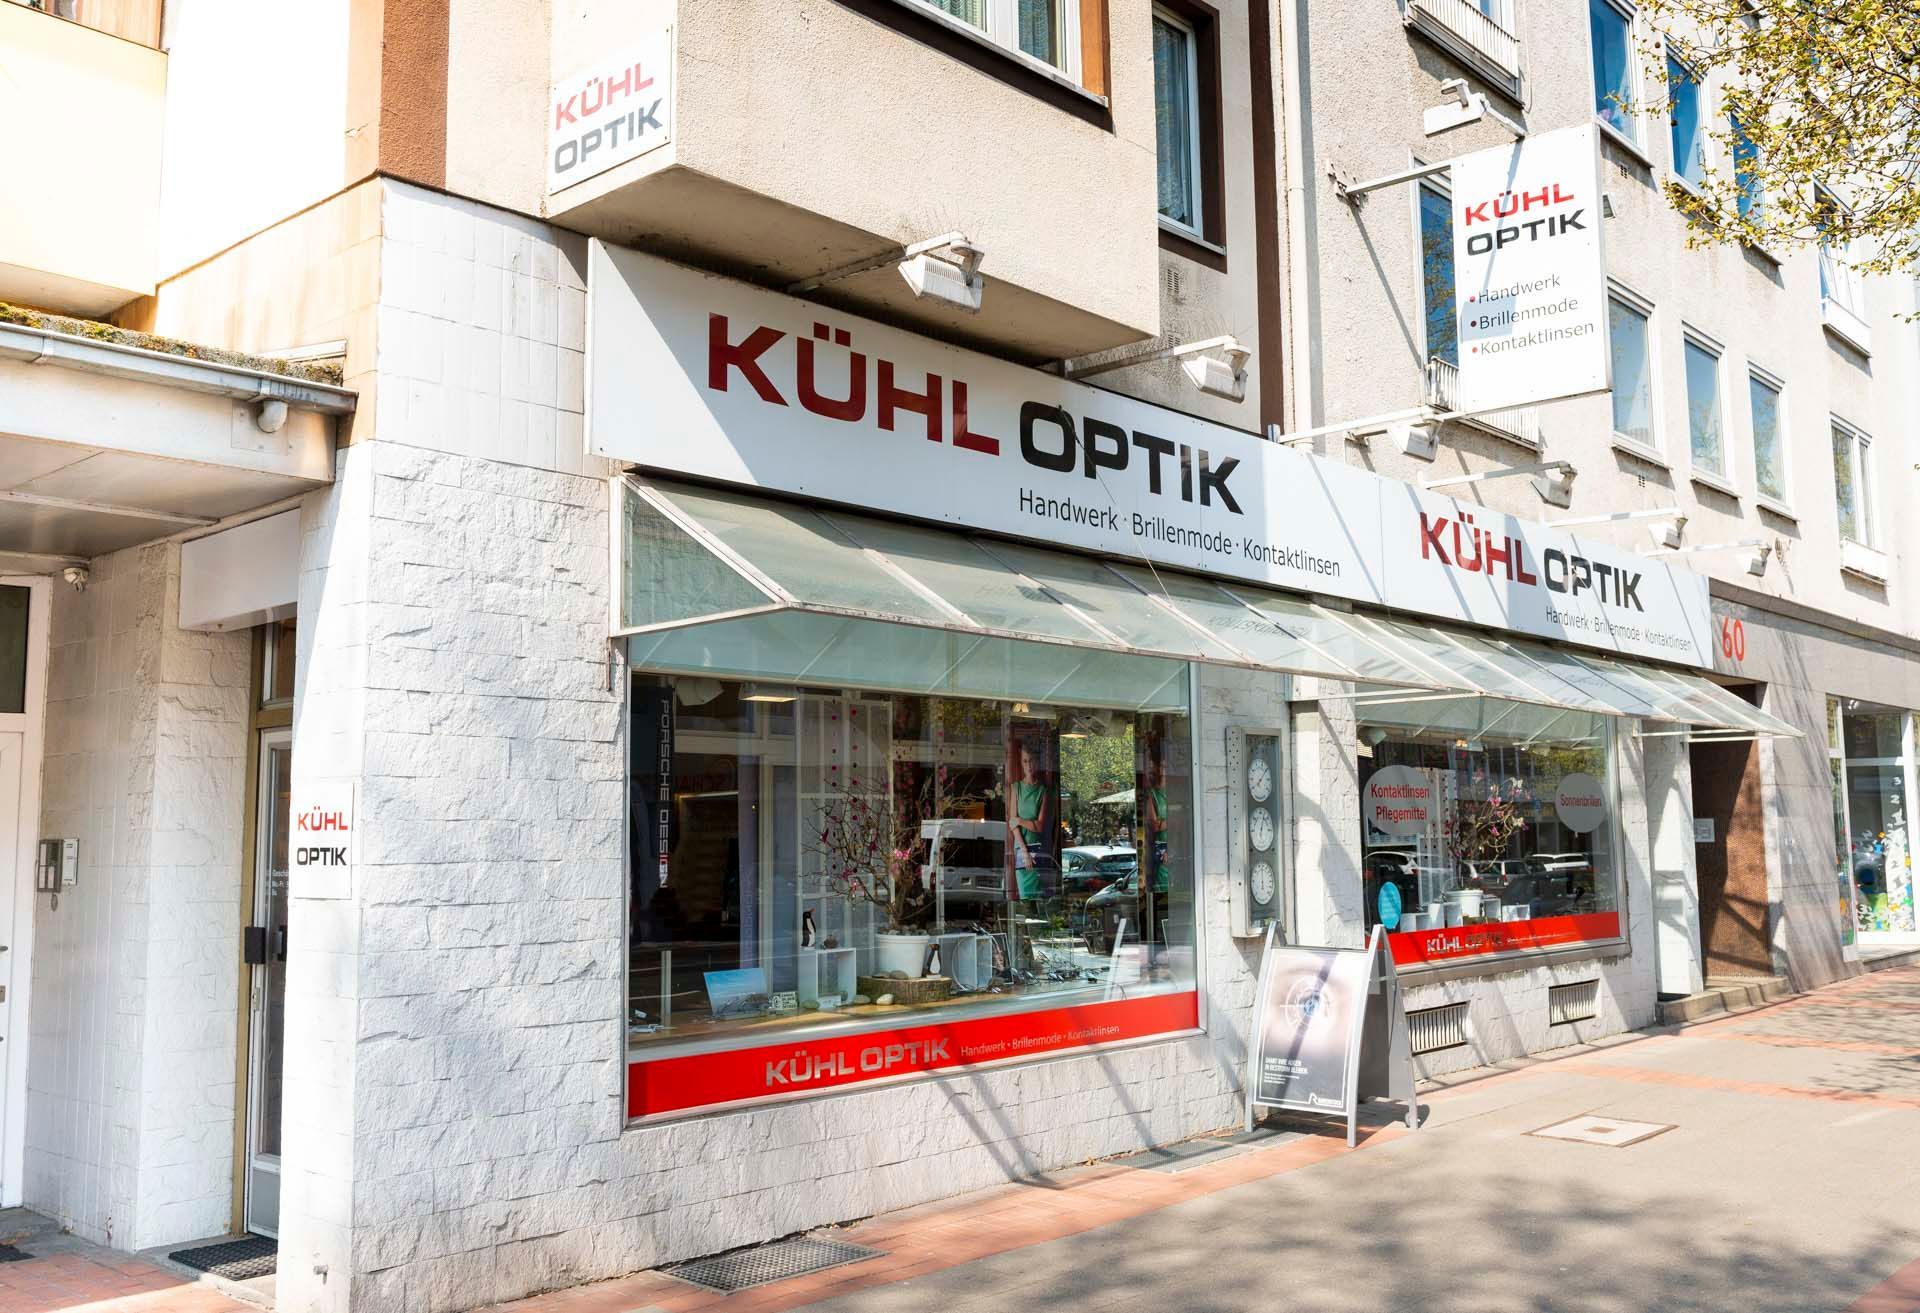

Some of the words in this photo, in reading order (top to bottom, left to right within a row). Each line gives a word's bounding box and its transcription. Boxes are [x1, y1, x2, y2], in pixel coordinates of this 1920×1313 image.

[555, 62, 654, 131] KÜHL
[554, 97, 663, 174] OPTIK
[1465, 183, 1574, 226] KÜHL
[1467, 208, 1587, 256] OPTIK
[1478, 274, 1561, 304] Handwerk
[1479, 297, 1578, 330] Brillenmode
[1481, 322, 1594, 356] Kontaktlinsen
[708, 312, 1000, 457] KÜHL
[1019, 400, 1244, 515] OPTIK
[1020, 487, 1119, 531] Handwerk
[1132, 512, 1232, 555] Brillenmode
[1243, 537, 1341, 577] Kontaktlinsen
[1419, 511, 1537, 587] KÜHL
[1544, 547, 1645, 613] OPTIK
[1546, 606, 1590, 631] Handwerk
[1594, 616, 1641, 641] Brillenmode
[1721, 617, 1745, 662] 60
[660, 699, 670, 801] PORSCHE
[1370, 783, 1430, 799] Kontaktlinsen
[297, 805, 348, 831] KÜHL
[1375, 805, 1427, 823] Pflegemittel
[297, 847, 347, 866] OPTIK
[659, 809, 669, 888] DESIGN
[1427, 933, 1463, 953] KÜHL
[765, 1050, 854, 1087] KÜHL
[860, 1038, 949, 1073] OPTIK
[961, 1040, 1005, 1057] Handwerk
[1012, 1033, 1062, 1050] Brillenmode
